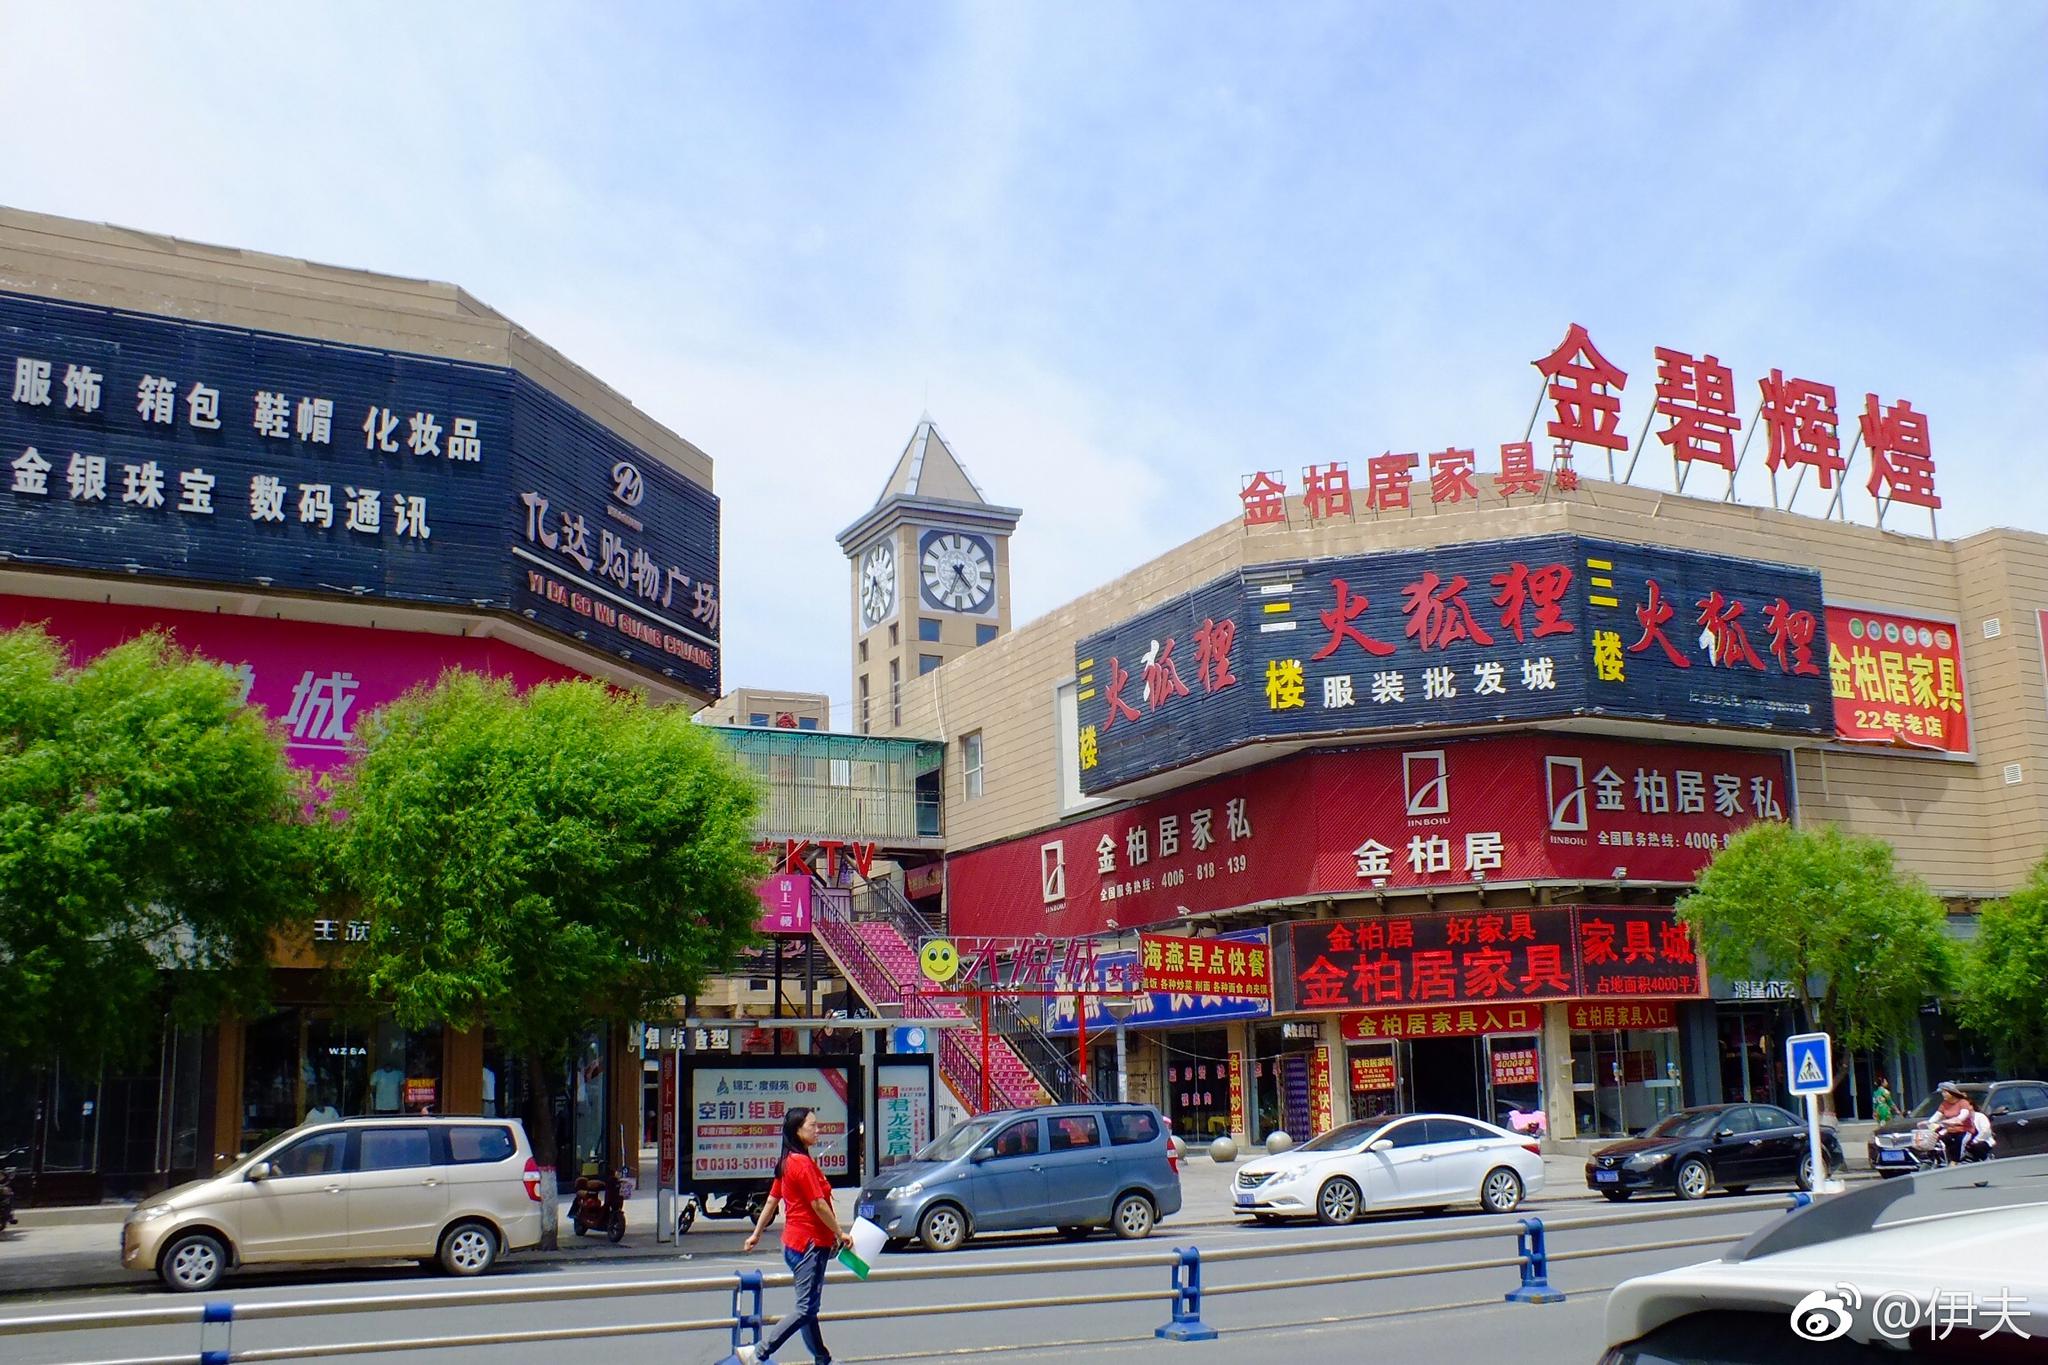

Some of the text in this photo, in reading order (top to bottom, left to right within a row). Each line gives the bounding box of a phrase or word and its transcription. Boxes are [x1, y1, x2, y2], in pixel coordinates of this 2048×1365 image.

[12, 357, 481, 462] 服饰 箱包 鞋帽 化妆品
[1532, 322, 1942, 510] 金碧辉煌
[11, 446, 431, 540] 金银珠宝 数码通讯
[1239, 440, 1545, 527] 金柏居家具
[521, 491, 719, 630] 亿达购物广场
[547, 580, 568, 607] DA
[594, 601, 616, 627] WU
[618, 613, 662, 648] GUANG
[1311, 562, 1575, 660] 火狐狸
[1627, 579, 1822, 676] 火狐狸
[1103, 618, 1236, 732] 火狐狸
[1323, 657, 1556, 709] 服装批发城
[1829, 642, 1962, 714] 金柏居家具
[1855, 710, 1943, 738] 22年老店
[1592, 765, 1783, 820] 金柏居家私
[785, 838, 876, 879] KTV
[1096, 798, 1252, 875] 金柏居家私
[1352, 832, 1504, 877] 金柏居
[961, 938, 1102, 984] 大悦城
[1143, 940, 1265, 978] 海燕早点快餐
[1327, 913, 1536, 953] 金柏居 好家具
[1581, 918, 1696, 964] 家具城
[1299, 944, 1572, 1006] 金柏居家具
[1734, 980, 1796, 999] 鸿星尔克
[1357, 1009, 1527, 1037] 金柏居家具入口
[1575, 1006, 1668, 1026] 金柏居家具入口
[1230, 1053, 1242, 1132] 各种炒菜
[1316, 1048, 1331, 1132] 早点快餐
